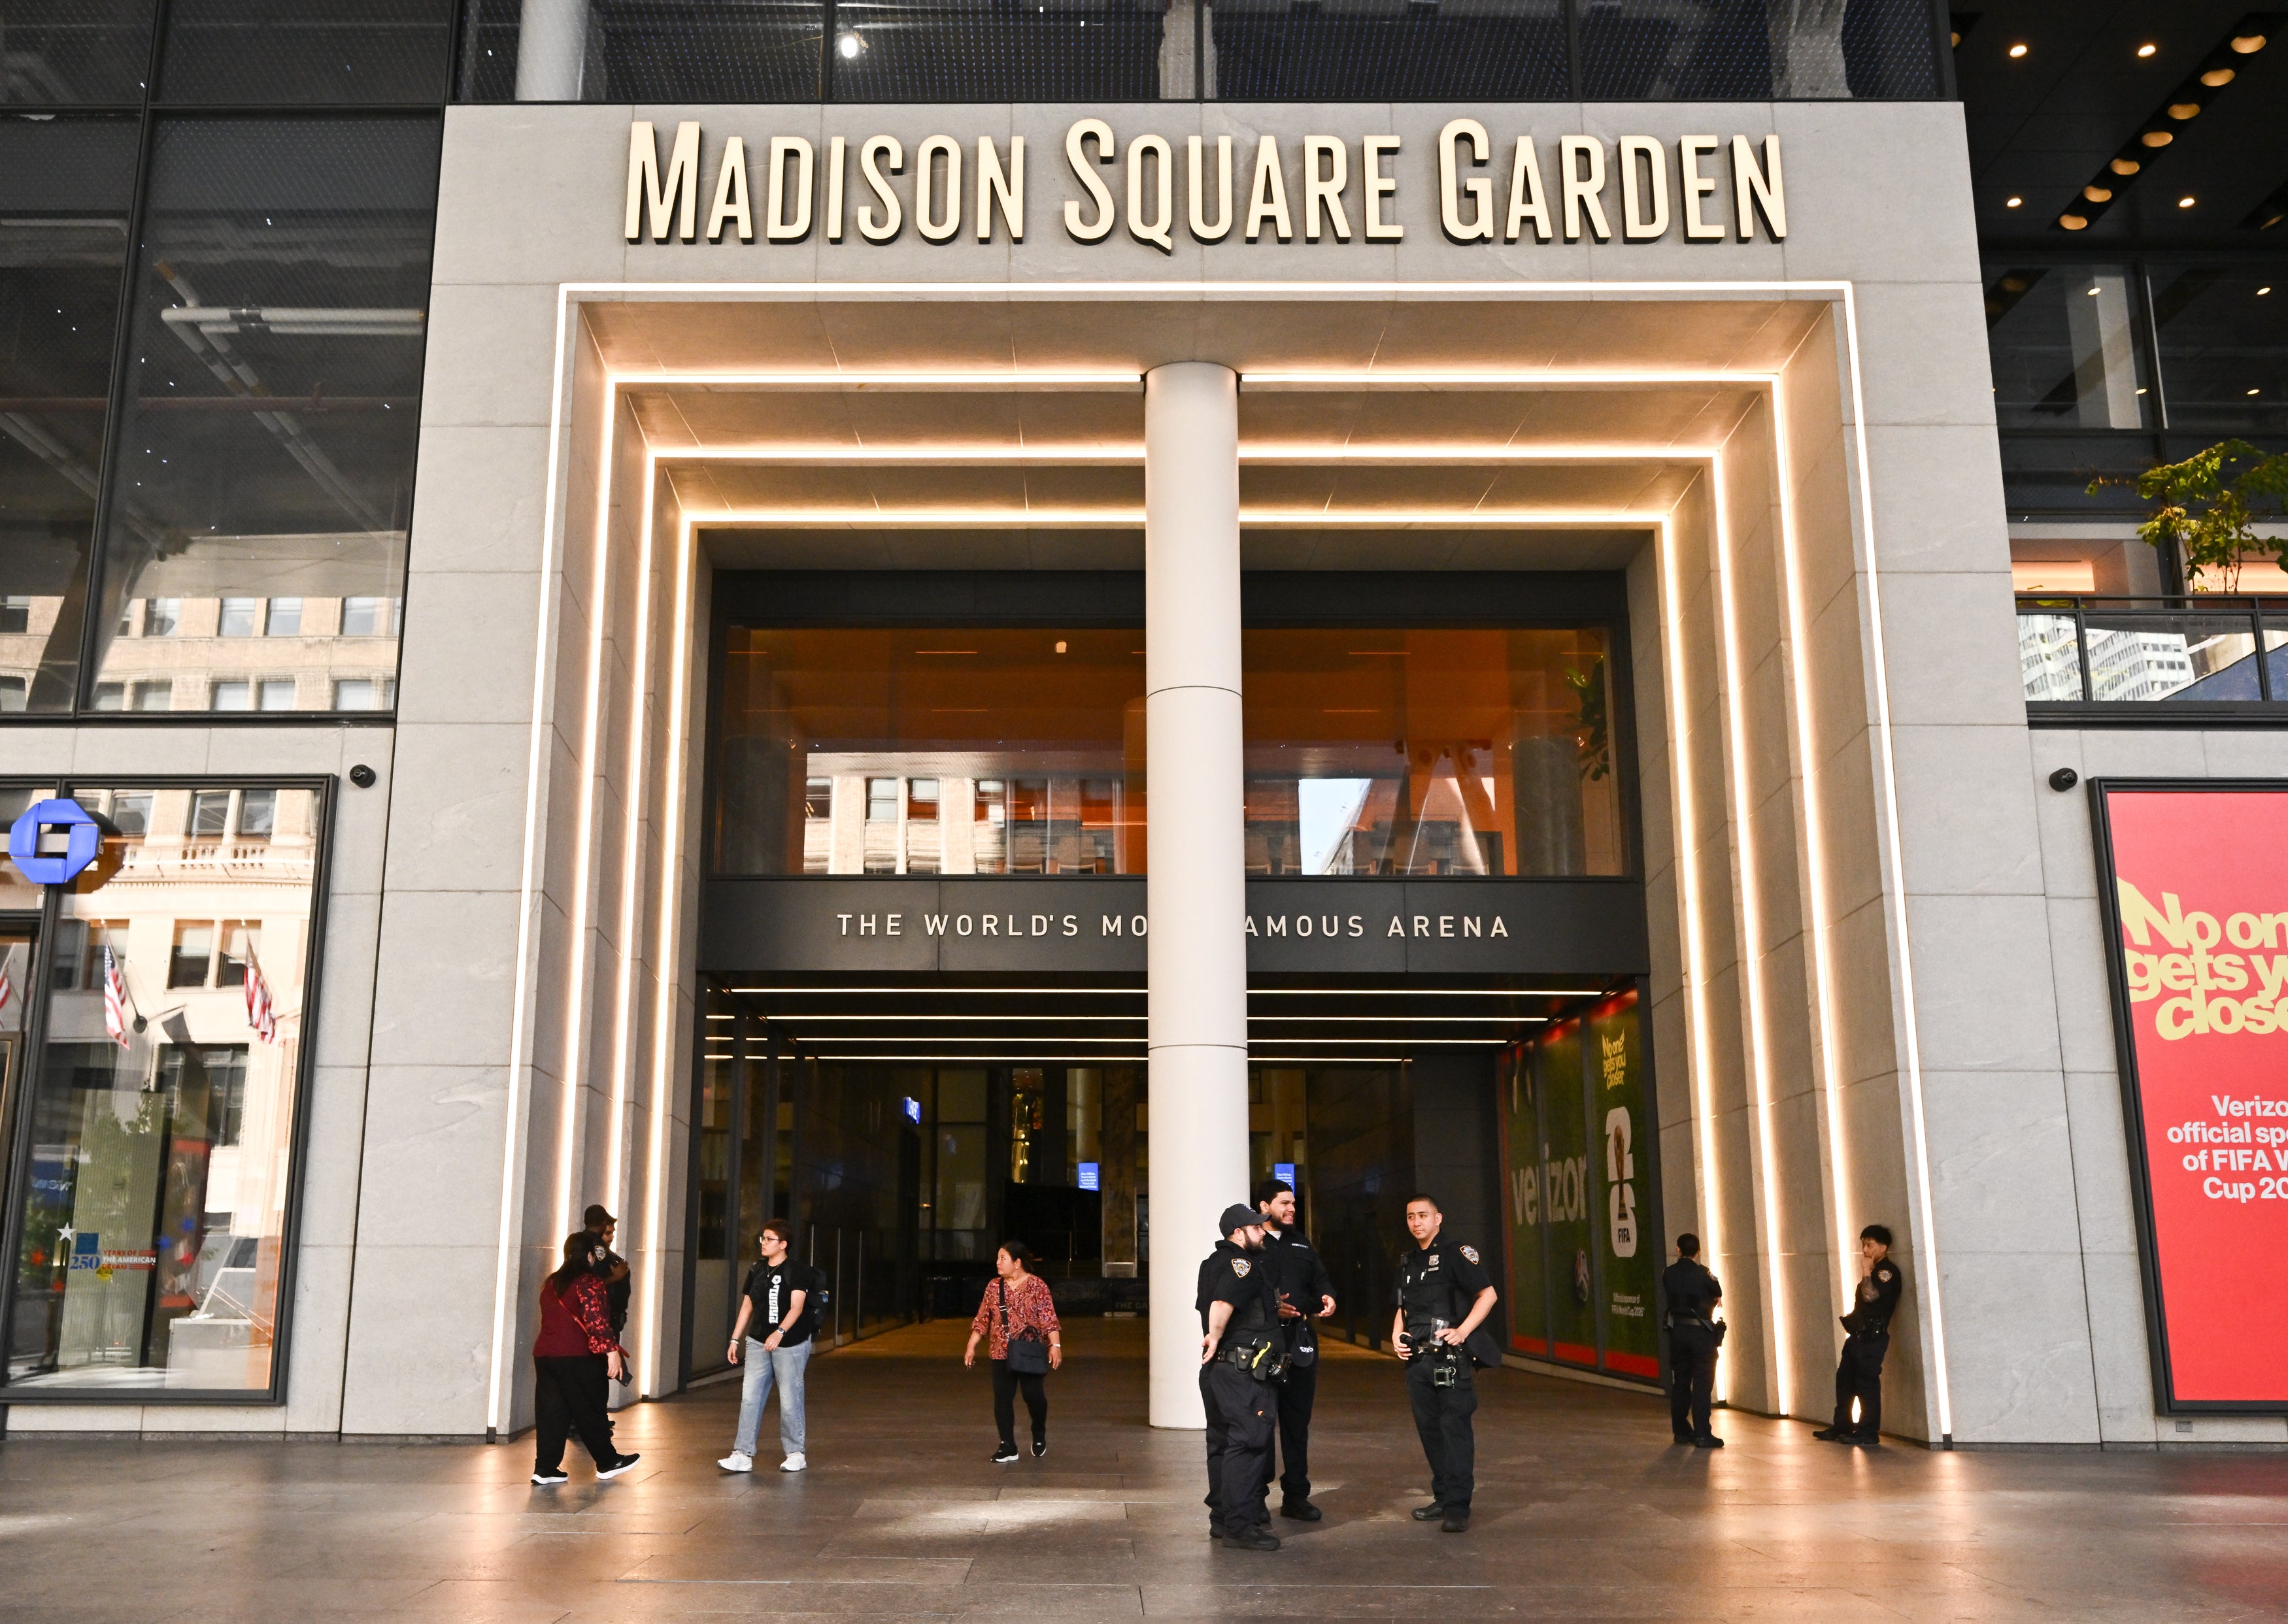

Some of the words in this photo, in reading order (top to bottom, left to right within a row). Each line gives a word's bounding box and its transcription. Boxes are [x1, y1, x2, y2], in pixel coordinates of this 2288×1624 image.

[625, 120, 1024, 244] MADISON
[1064, 118, 1404, 256] SQUARE
[1439, 118, 1787, 244] GARDEN
[2116, 876, 2221, 949] No
[837, 914, 901, 936] THE
[924, 914, 1078, 936] WORLD'S
[1102, 914, 1148, 936] MO
[1245, 916, 1363, 937] AMOUS
[1387, 916, 1508, 937] ARENA
[2125, 946, 2249, 1003] gets
[2249, 955, 2288, 1001] y
[2211, 1095, 2288, 1117] Verizo
[2167, 1121, 2251, 1143] official
[2255, 1127, 2288, 1148] sp
[2182, 1150, 2208, 1171] of
[2212, 1150, 2272, 1171] FIFA
[2203, 1176, 2256, 1204] Cup
[2259, 1177, 2288, 1199] 20
[1618, 1227, 1630, 1243] FIFA
[69, 1256, 100, 1270] 250
